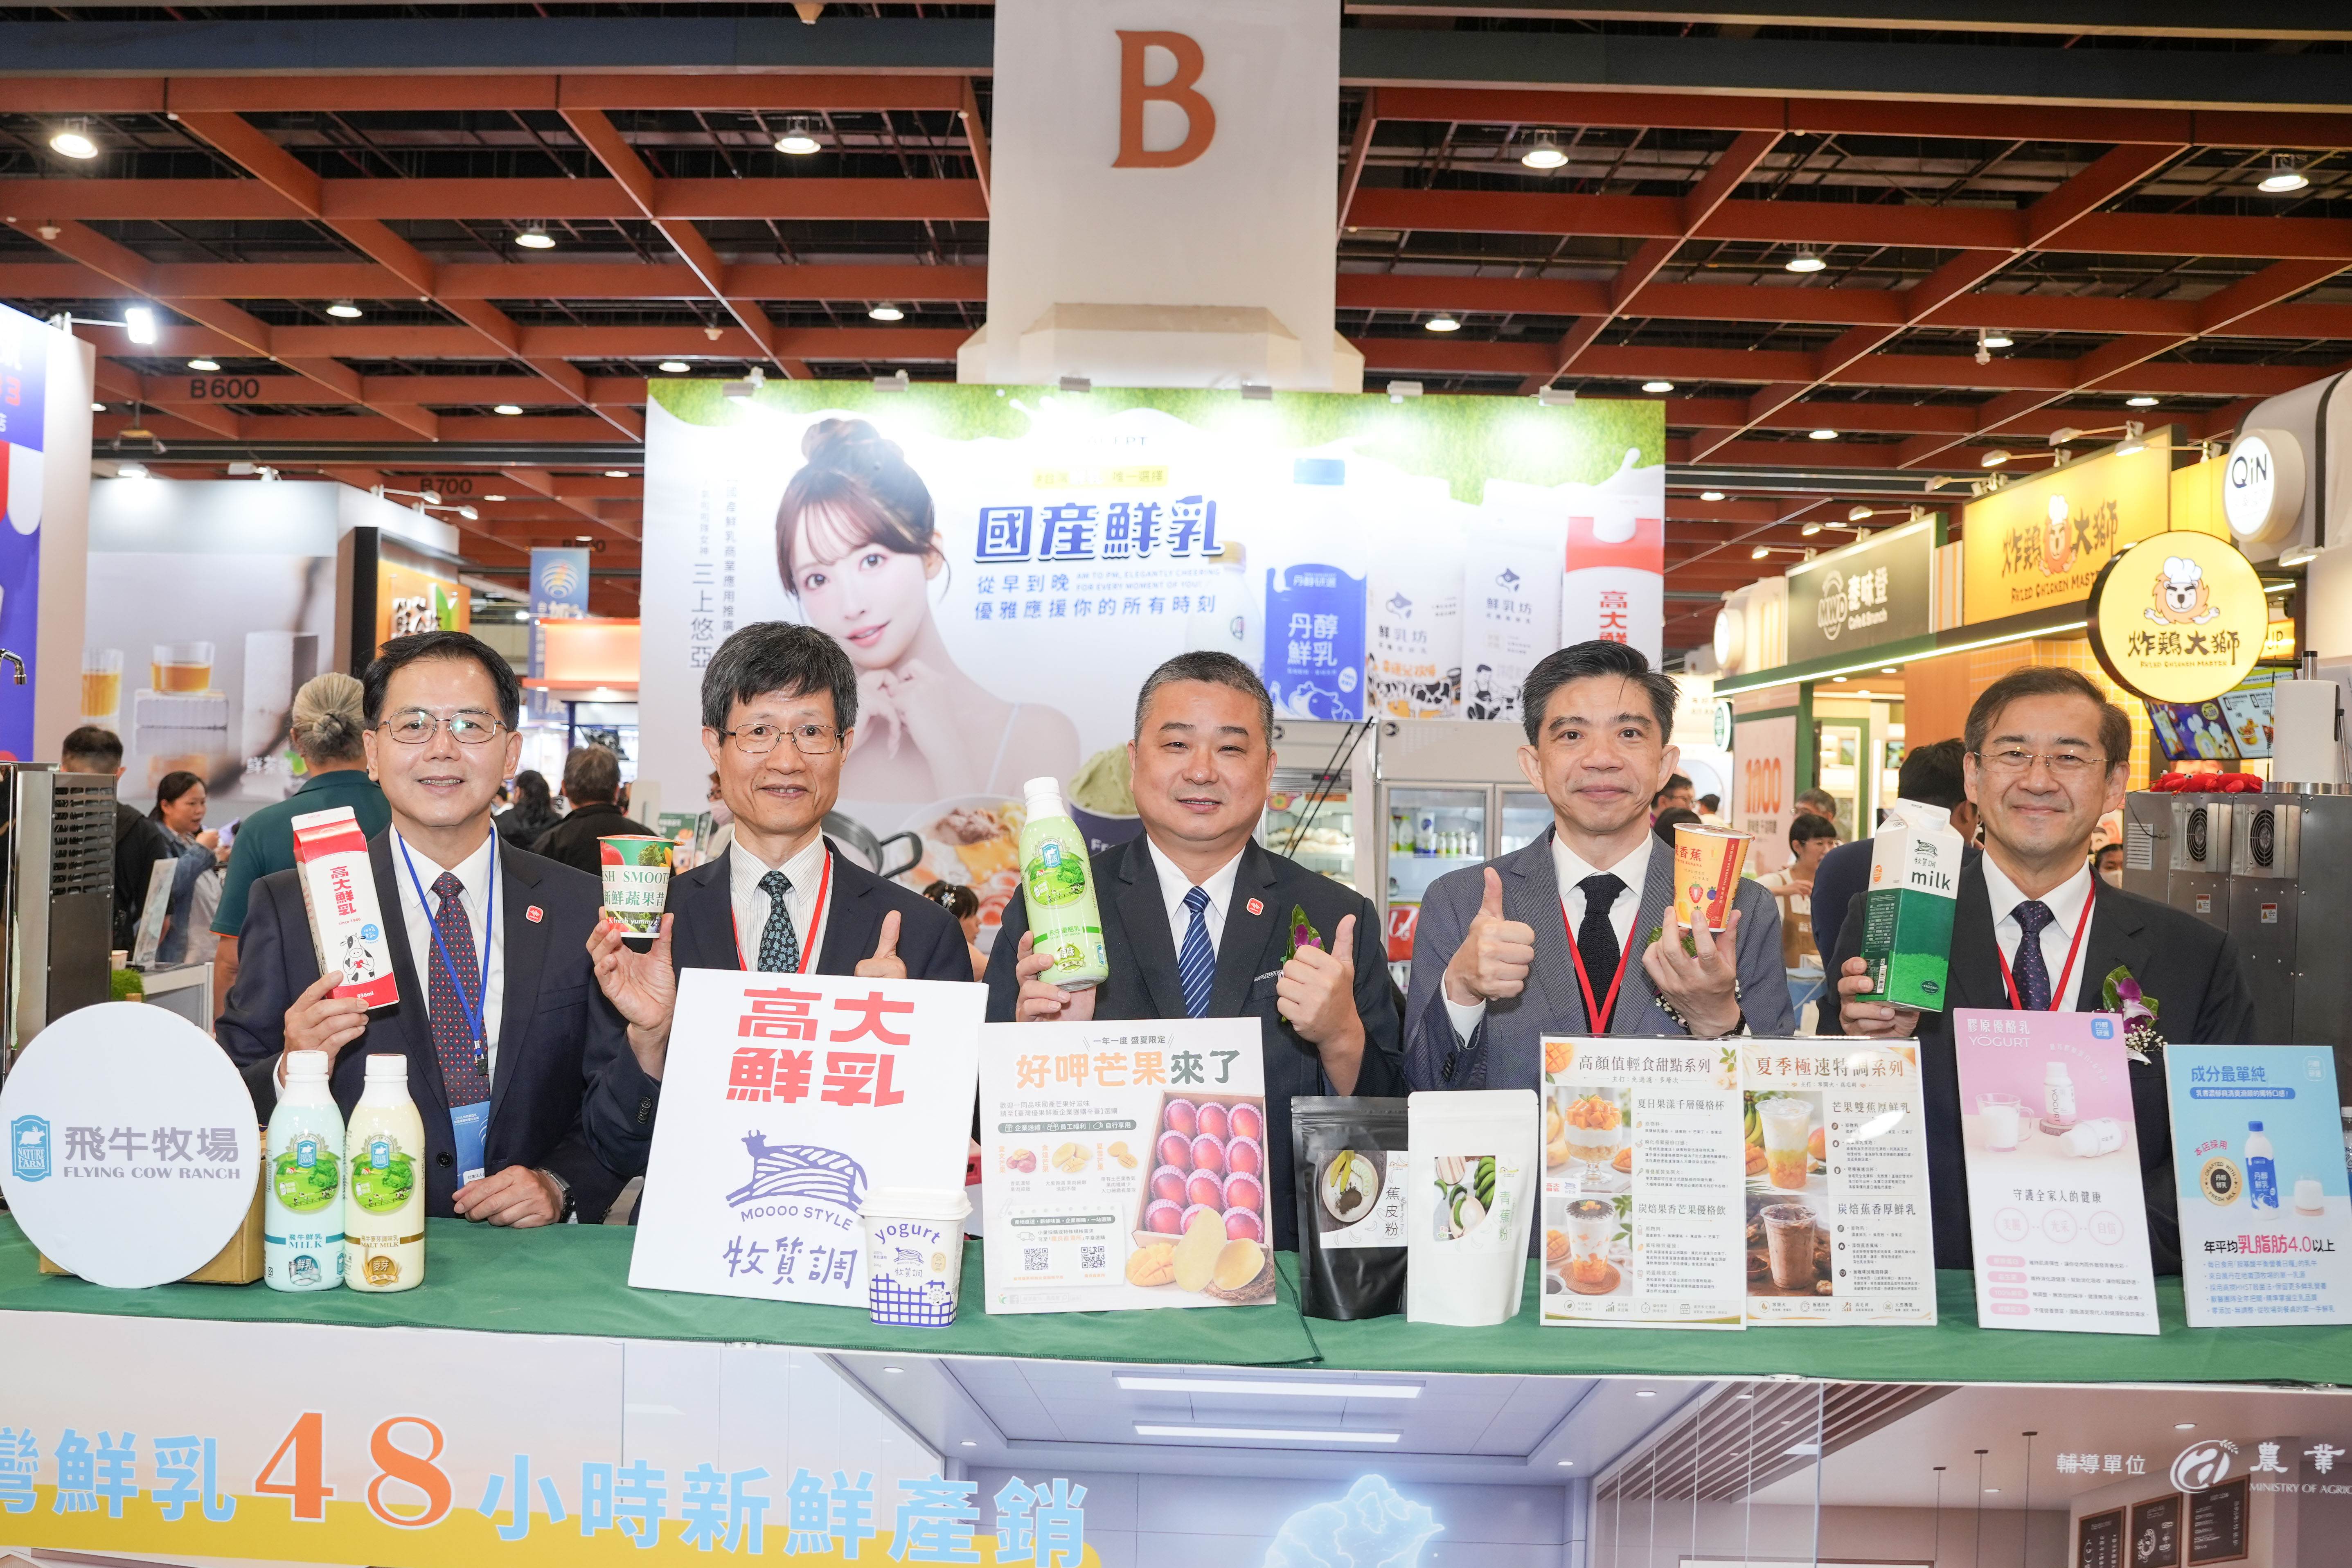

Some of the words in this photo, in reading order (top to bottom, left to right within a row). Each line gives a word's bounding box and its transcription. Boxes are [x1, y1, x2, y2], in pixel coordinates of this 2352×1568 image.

[1112, 30, 1216, 168] B
[191, 378, 260, 399] B600
[977, 574, 1070, 594] 從早到晚
[975, 594, 1216, 620] 優雅應援你的所有時刻
[1287, 640, 1338, 667] 鮮乳
[1912, 869, 1951, 891] milk
[330, 865, 357, 916] 高大鮮乳
[357, 990, 374, 999] 936ml
[737, 987, 915, 1045] 高大
[1967, 1018, 2030, 1035] 膠原優酪乳
[1131, 1035, 1166, 1045] 盛夏限定
[1016, 1050, 1240, 1089] 好呷芒果來了
[1579, 1055, 1711, 1073] 高顏值輕食甜點系列
[1755, 1057, 1904, 1077] 夏季極速特調系列
[726, 1046, 904, 1107] 鮮乳
[2191, 1066, 2266, 1082] 成分最單純
[1000, 1101, 1090, 1109] 歡迎一同品味國產芒果好滋味
[1637, 1098, 1725, 1111] 夏日果漾千層優格杯
[1832, 1101, 1910, 1113] 芒果雙蕉厚鮮乳
[65, 1126, 239, 1162] 飛牛牧場
[2194, 1139, 2228, 1157] 本店採用
[18, 1147, 45, 1160] NATURE
[18, 1158, 45, 1169] FARM
[2206, 1161, 2224, 1176] CRAFTED
[2226, 1165, 2236, 1177] WITH
[64, 1166, 125, 1178] FLYING
[131, 1167, 172, 1179] COW
[179, 1168, 240, 1180] RANCH
[2013, 1188, 2102, 1203] 守護全家人的健康
[2208, 1192, 2224, 1202] FRESH
[2226, 1192, 2236, 1201] MILK
[1385, 1186, 1400, 1237] 蕉皮粉
[1499, 1190, 1512, 1241] 青蕉粉
[1638, 1203, 1726, 1216] 炭焙果香芒果優格飲
[1838, 1203, 1916, 1215] 炭焙蕉香厚鮮乳
[741, 1205, 798, 1223] MOOOO
[804, 1206, 854, 1232] STYLE
[874, 1223, 941, 1245] yogurt
[288, 1240, 323, 1248] MILK
[373, 1260, 390, 1271] 麥芽
[722, 1235, 858, 1289] 牧質調
[2056, 1453, 2147, 1475] 輔導單位
[2250, 1483, 2300, 1494] MINISTRY
[2302, 1483, 2317, 1494] OF
